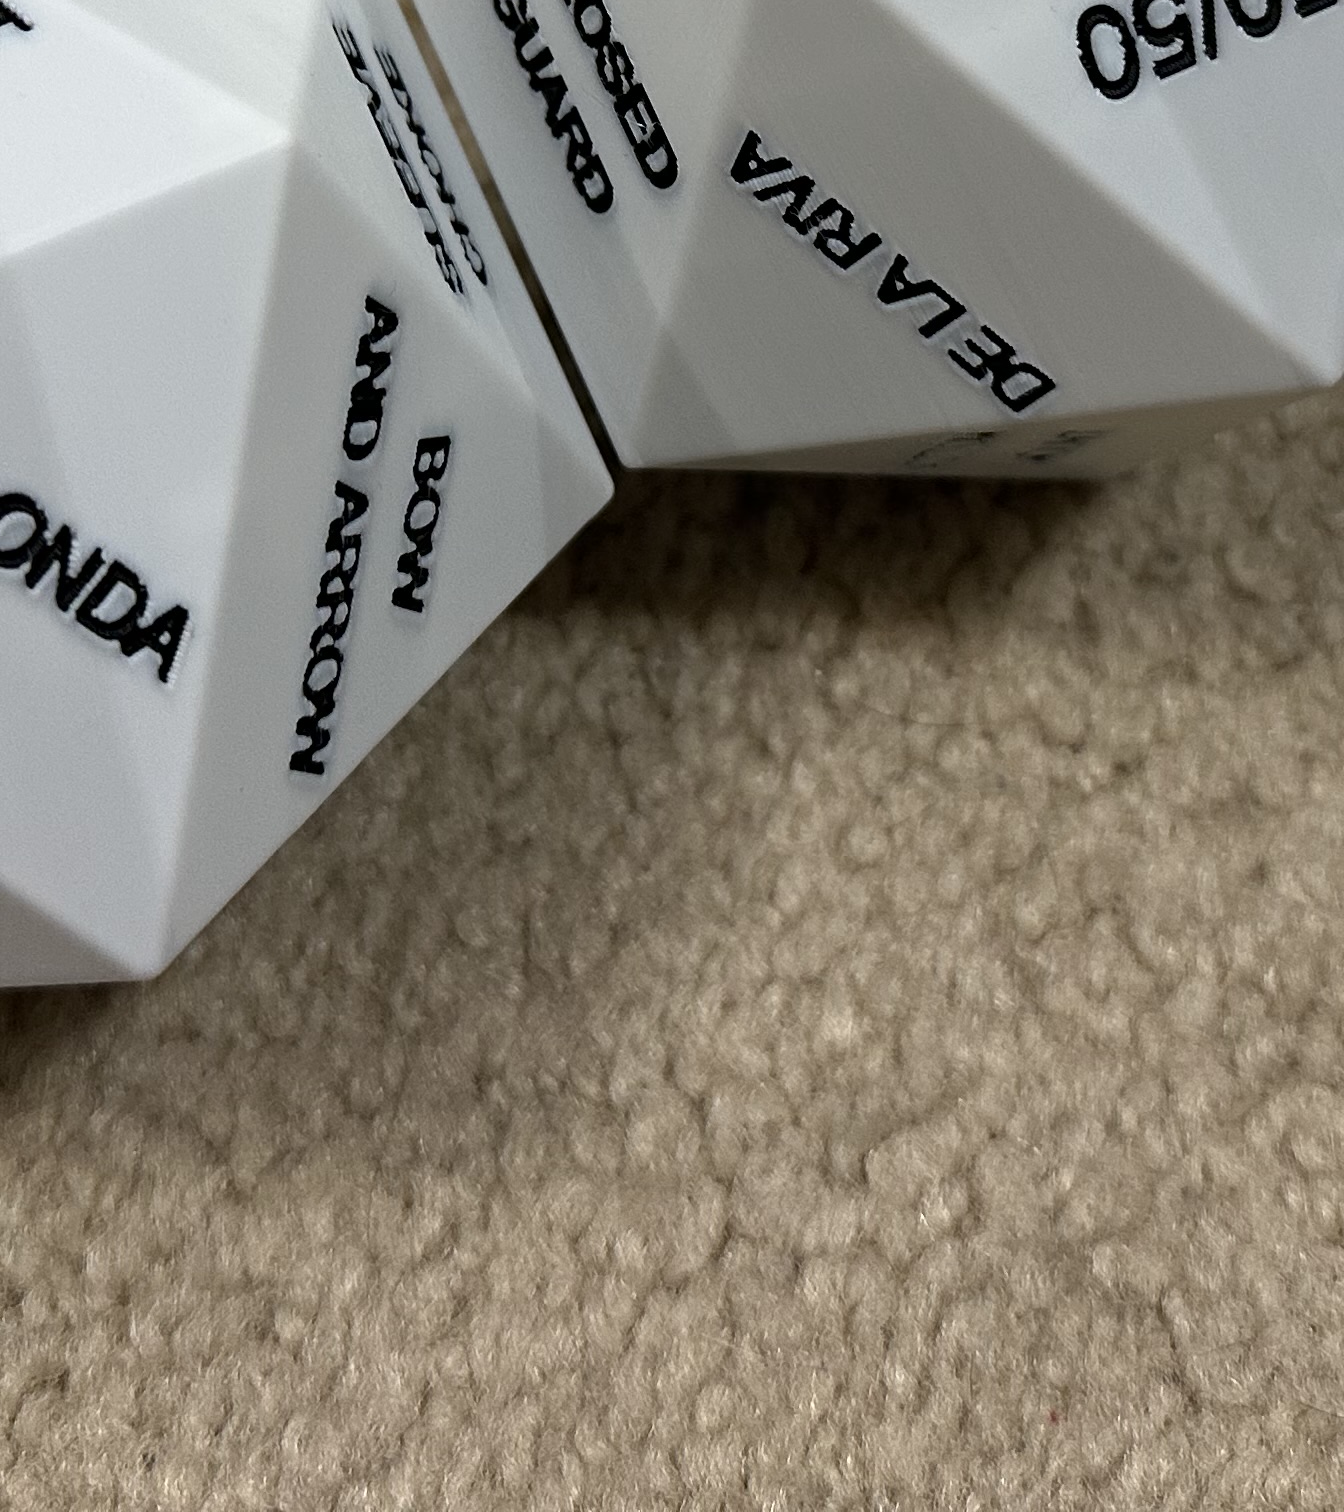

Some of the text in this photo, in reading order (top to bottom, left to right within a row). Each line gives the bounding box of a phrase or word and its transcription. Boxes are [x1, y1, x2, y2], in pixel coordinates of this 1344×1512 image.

[331, 20, 464, 295] SLEEVE
[373, 45, 488, 287] CHOKE
[730, 129, 1057, 413] DE LA RIVA
[288, 294, 399, 776] AND ARROW
[391, 434, 452, 614] BOW
